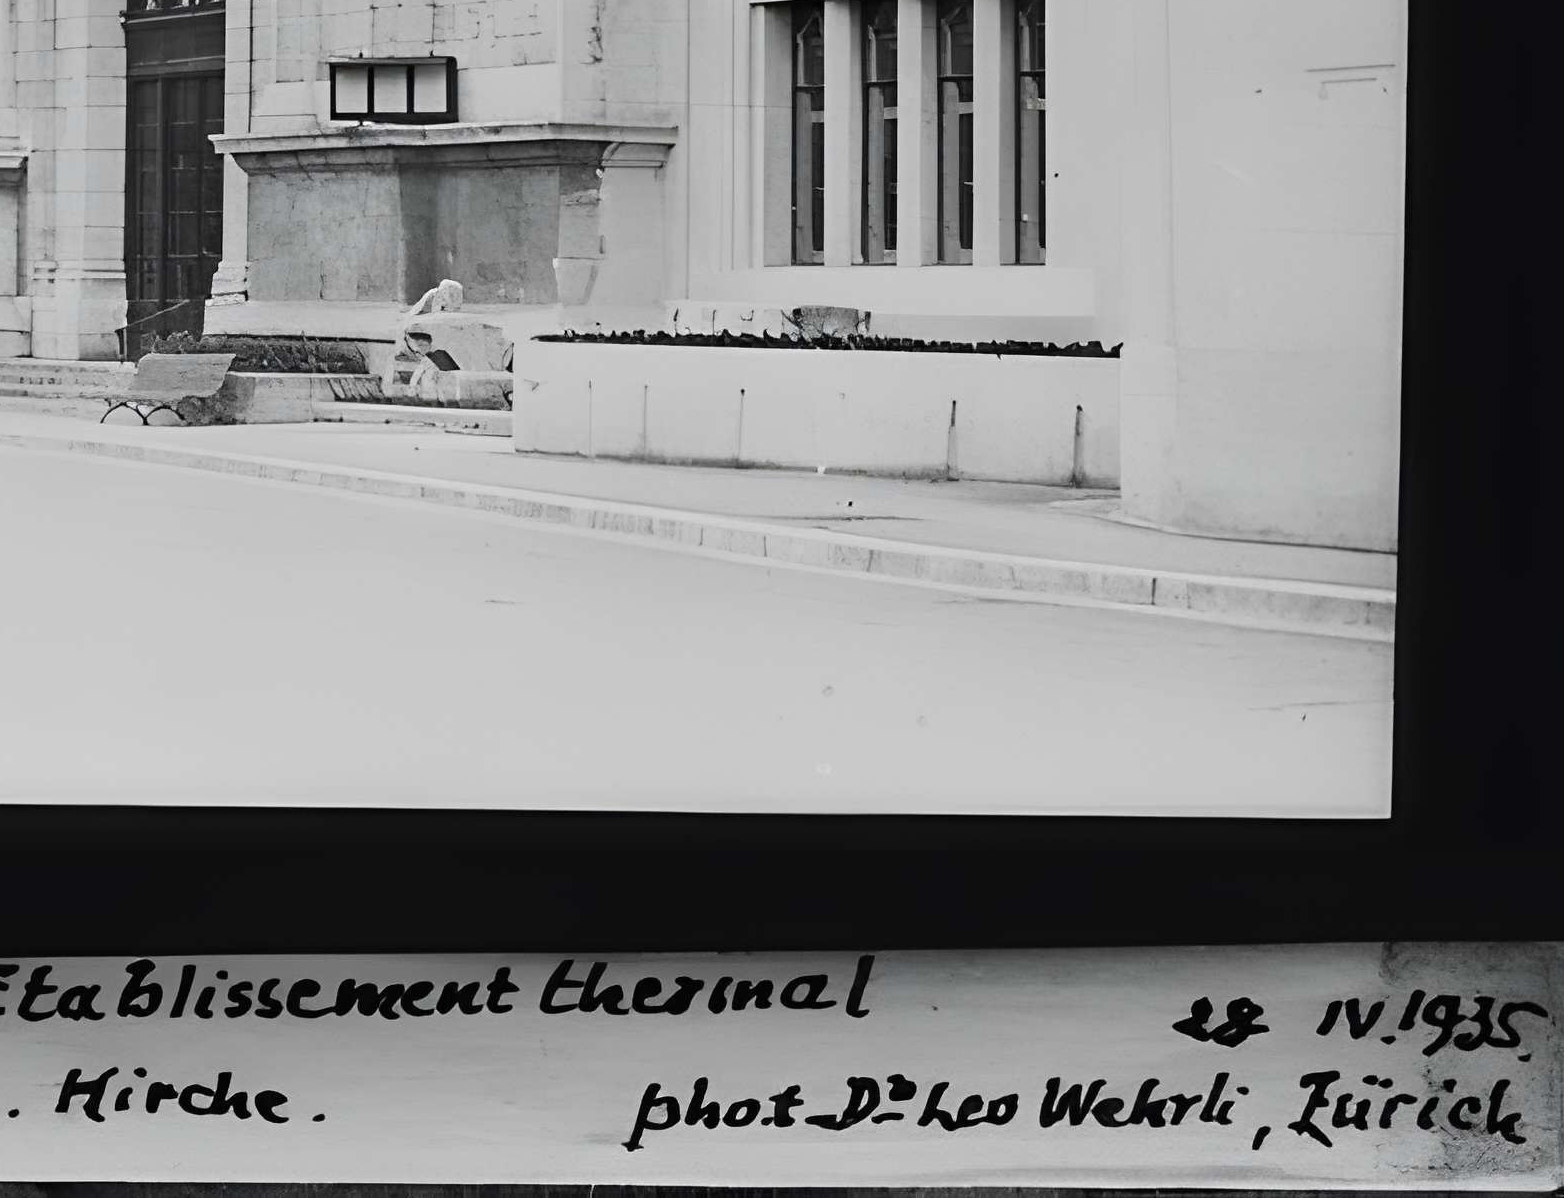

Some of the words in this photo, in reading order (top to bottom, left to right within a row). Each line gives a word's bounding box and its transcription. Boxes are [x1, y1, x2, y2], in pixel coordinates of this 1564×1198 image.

[539, 954, 876, 1019] thermal
[916, 1080, 1020, 1132] Leo
[1286, 1069, 1529, 1149] Zürich
